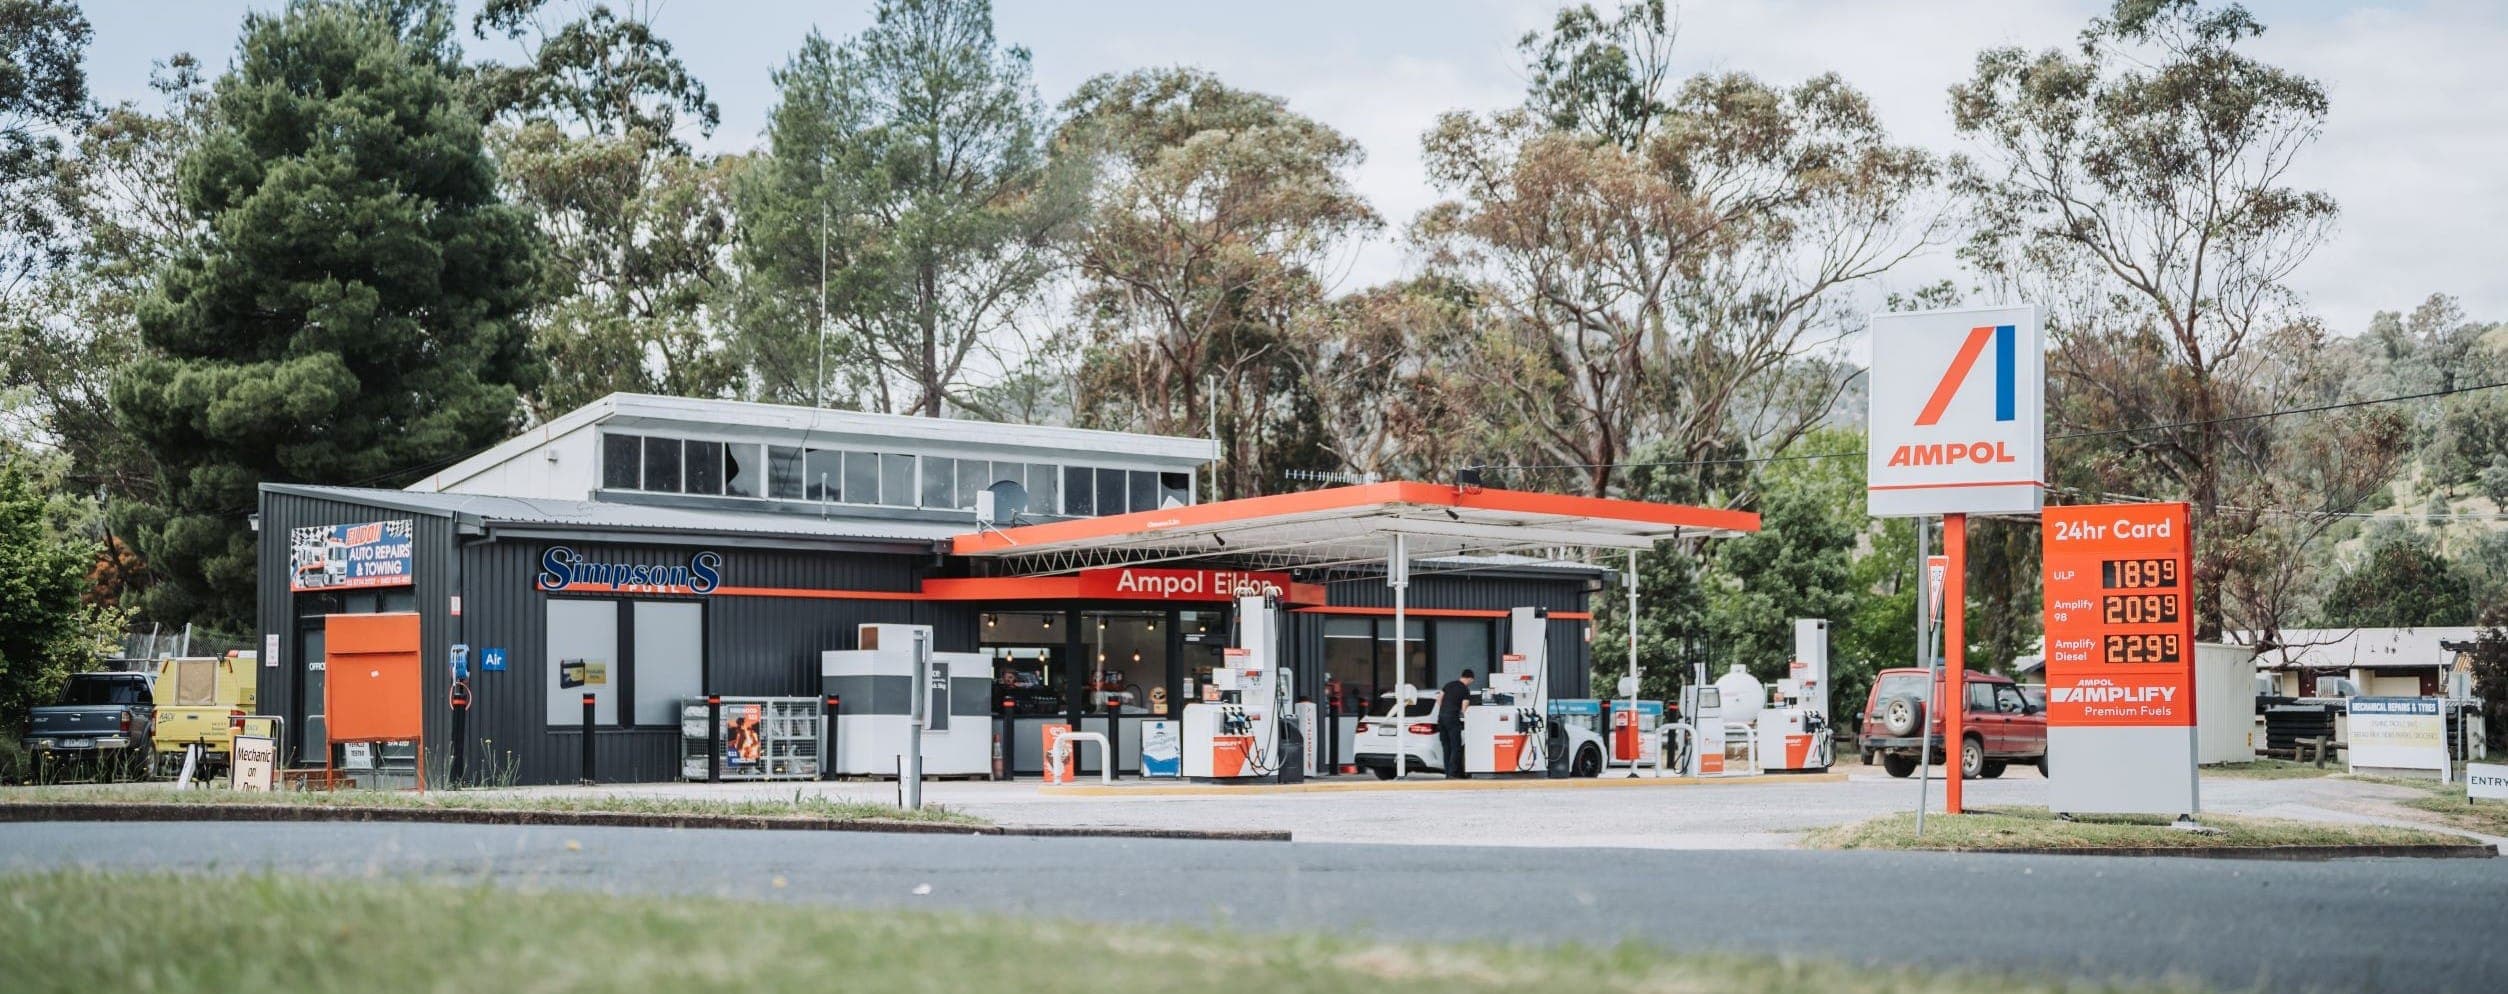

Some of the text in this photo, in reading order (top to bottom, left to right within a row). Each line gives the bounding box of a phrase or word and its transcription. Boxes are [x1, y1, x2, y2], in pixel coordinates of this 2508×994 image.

[1888, 441, 2015, 467] AMPOL
[2054, 517, 2171, 541] 24hr Card
[349, 544, 411, 561] AUTO REPAIRS
[356, 561, 402, 576] & TOWING
[2053, 560, 2175, 588] ULP 1899
[1116, 569, 1203, 598] Ampol
[2054, 596, 2177, 623] Amplify 2099
[2054, 612, 2068, 622] 98
[2055, 635, 2177, 663] Amplify 2299
[2055, 651, 2087, 661] Diesel
[486, 653, 502, 665] Air
[2077, 679, 2114, 687] AMPOL
[2065, 686, 2177, 703] AMPLIFY
[2084, 706, 2172, 716] Premium Fuels
[2352, 702, 2436, 713] MECHANICAL REPAIRS & TYRES
[237, 747, 271, 763] Mechanic
[247, 767, 257, 778] on
